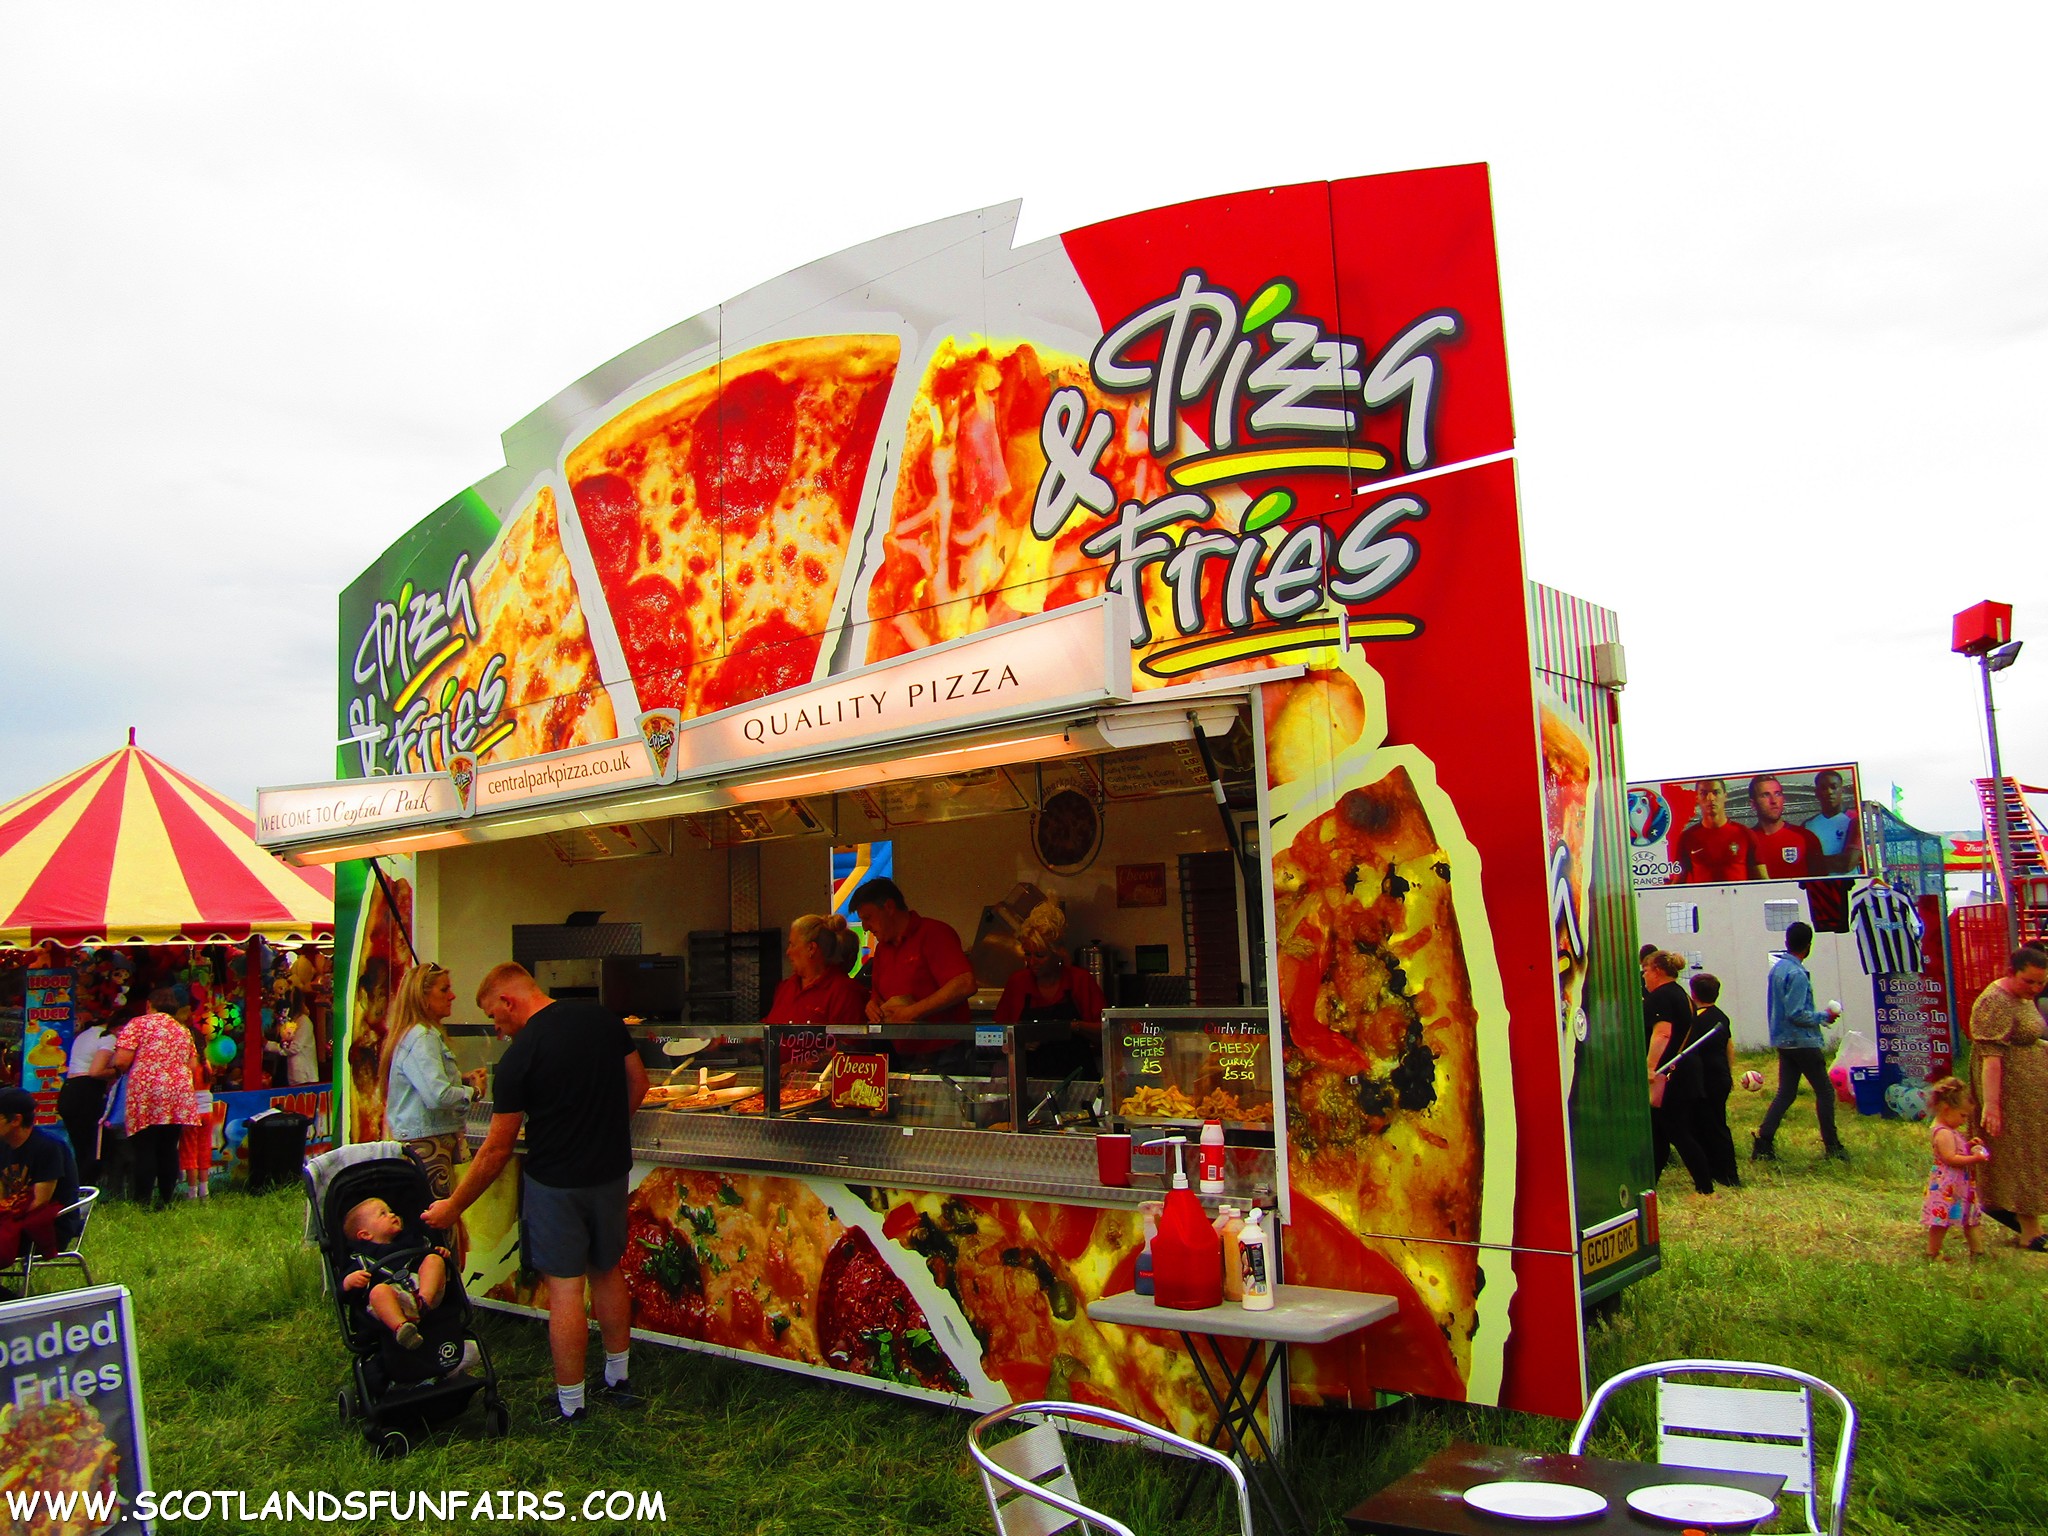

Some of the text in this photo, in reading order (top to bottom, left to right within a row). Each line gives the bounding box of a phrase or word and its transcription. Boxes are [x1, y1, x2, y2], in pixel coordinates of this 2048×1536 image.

[1091, 269, 1460, 472] Pizza
[1029, 385, 1430, 643] & Fries
[353, 552, 477, 700] Pizza
[743, 664, 1019, 744] QUALITY PIZZA
[386, 653, 506, 775] Fries
[488, 750, 631, 794] centralparkpizza.co.uk
[261, 778, 442, 831] WELCOME TO Central Park
[1633, 877, 1664, 885] RANCE
[28, 975, 71, 989] HOOK
[1879, 980, 1941, 992] 1 Shot In
[44, 992, 56, 1005] A
[1914, 996, 1938, 1004] Prize
[28, 1007, 70, 1021] DUCK
[1878, 1009, 1947, 1022] 2 Shots In
[1134, 1022, 1165, 1035] Chips
[1204, 1022, 1267, 1035] Curly Fries
[1921, 1026, 1946, 1035] Prize
[780, 1031, 836, 1050] LOADED
[1123, 1036, 1167, 1048] CHEESY
[1880, 1038, 1949, 1052] 3 Shots In
[1131, 1047, 1165, 1057] CHIPS
[1208, 1041, 1260, 1058] CHEESY
[835, 1055, 878, 1080] Cheesy
[1141, 1057, 1162, 1074] £5
[851, 1079, 885, 1102] Chips
[1133, 1146, 1164, 1156] FORKS
[1587, 1225, 1634, 1266] GC07 GRC
[0, 1310, 118, 1369] aded
[14, 1363, 123, 1411] Fries
